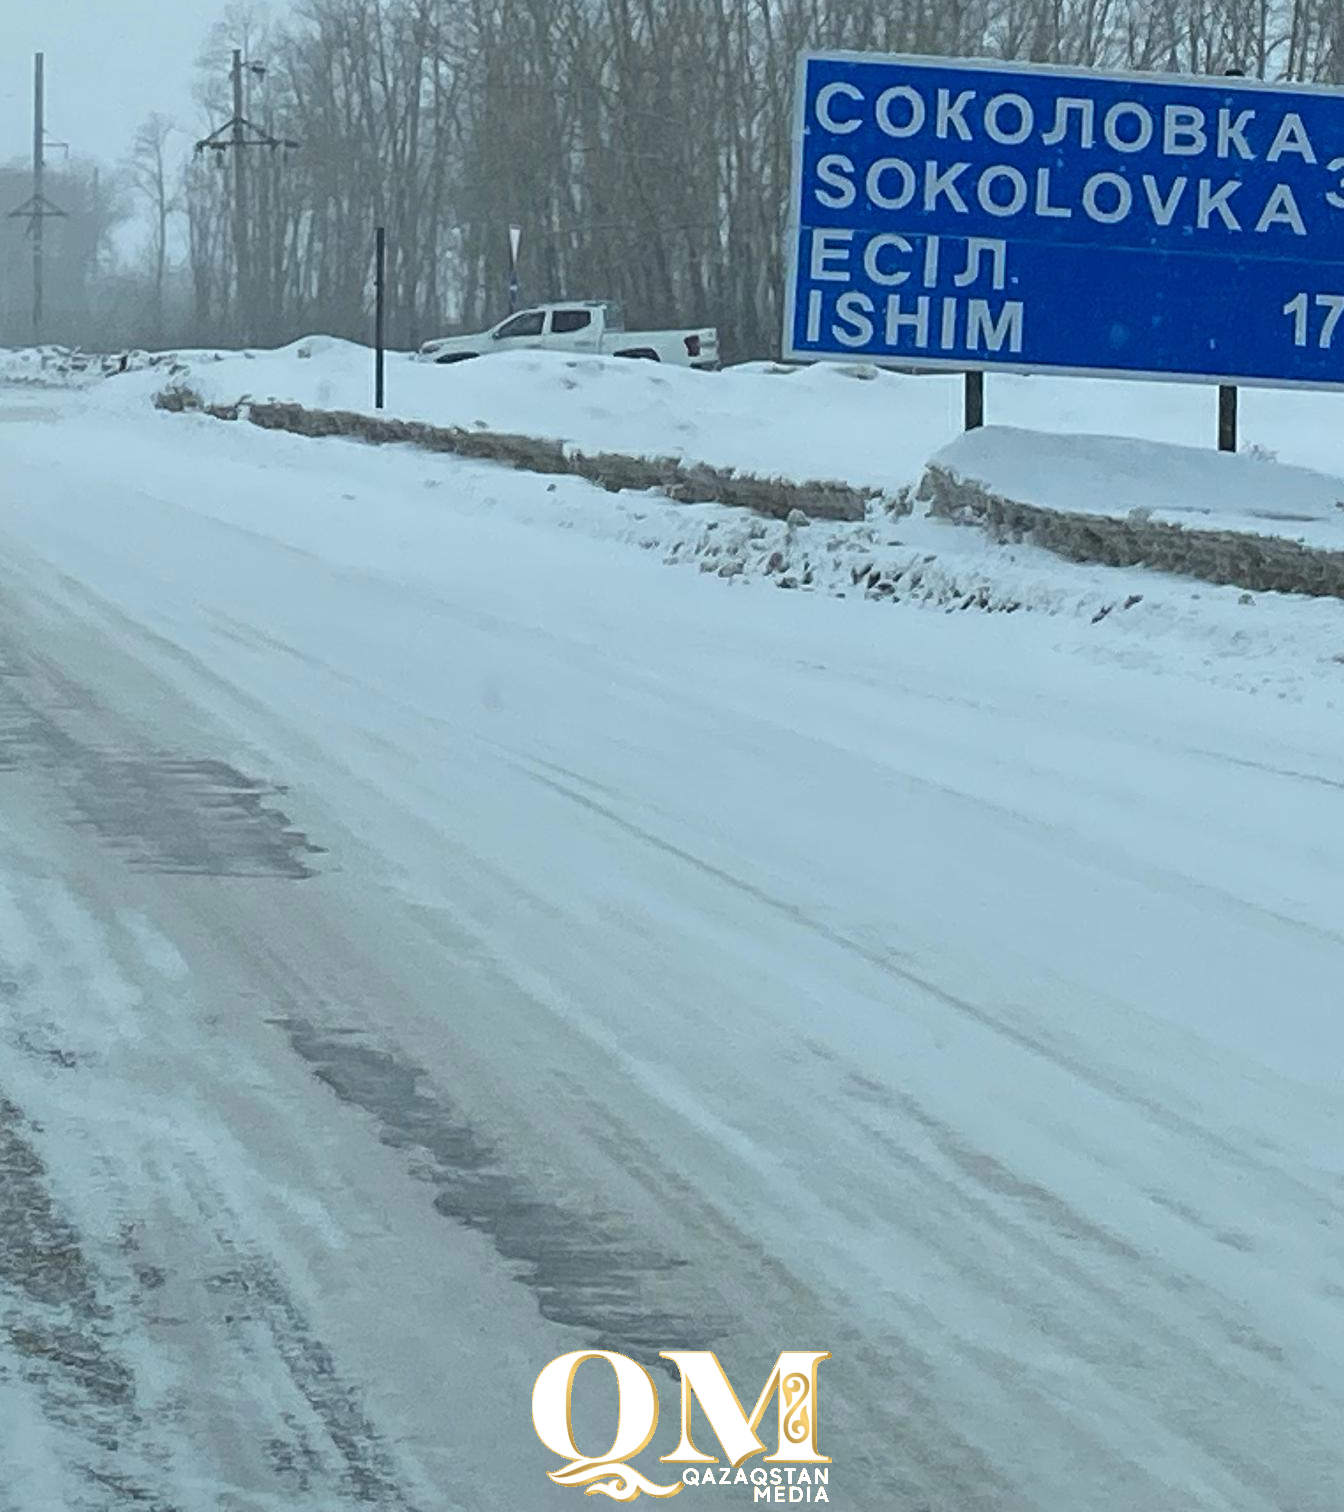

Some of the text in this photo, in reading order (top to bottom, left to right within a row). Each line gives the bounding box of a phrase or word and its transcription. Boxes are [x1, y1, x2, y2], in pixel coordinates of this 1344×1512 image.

[816, 82, 1317, 164] СОКОЛОВКА
[814, 154, 1307, 236] SOKOLOVKA
[810, 228, 1006, 290] ЕСІЛ
[807, 289, 1024, 353] ISHIM
